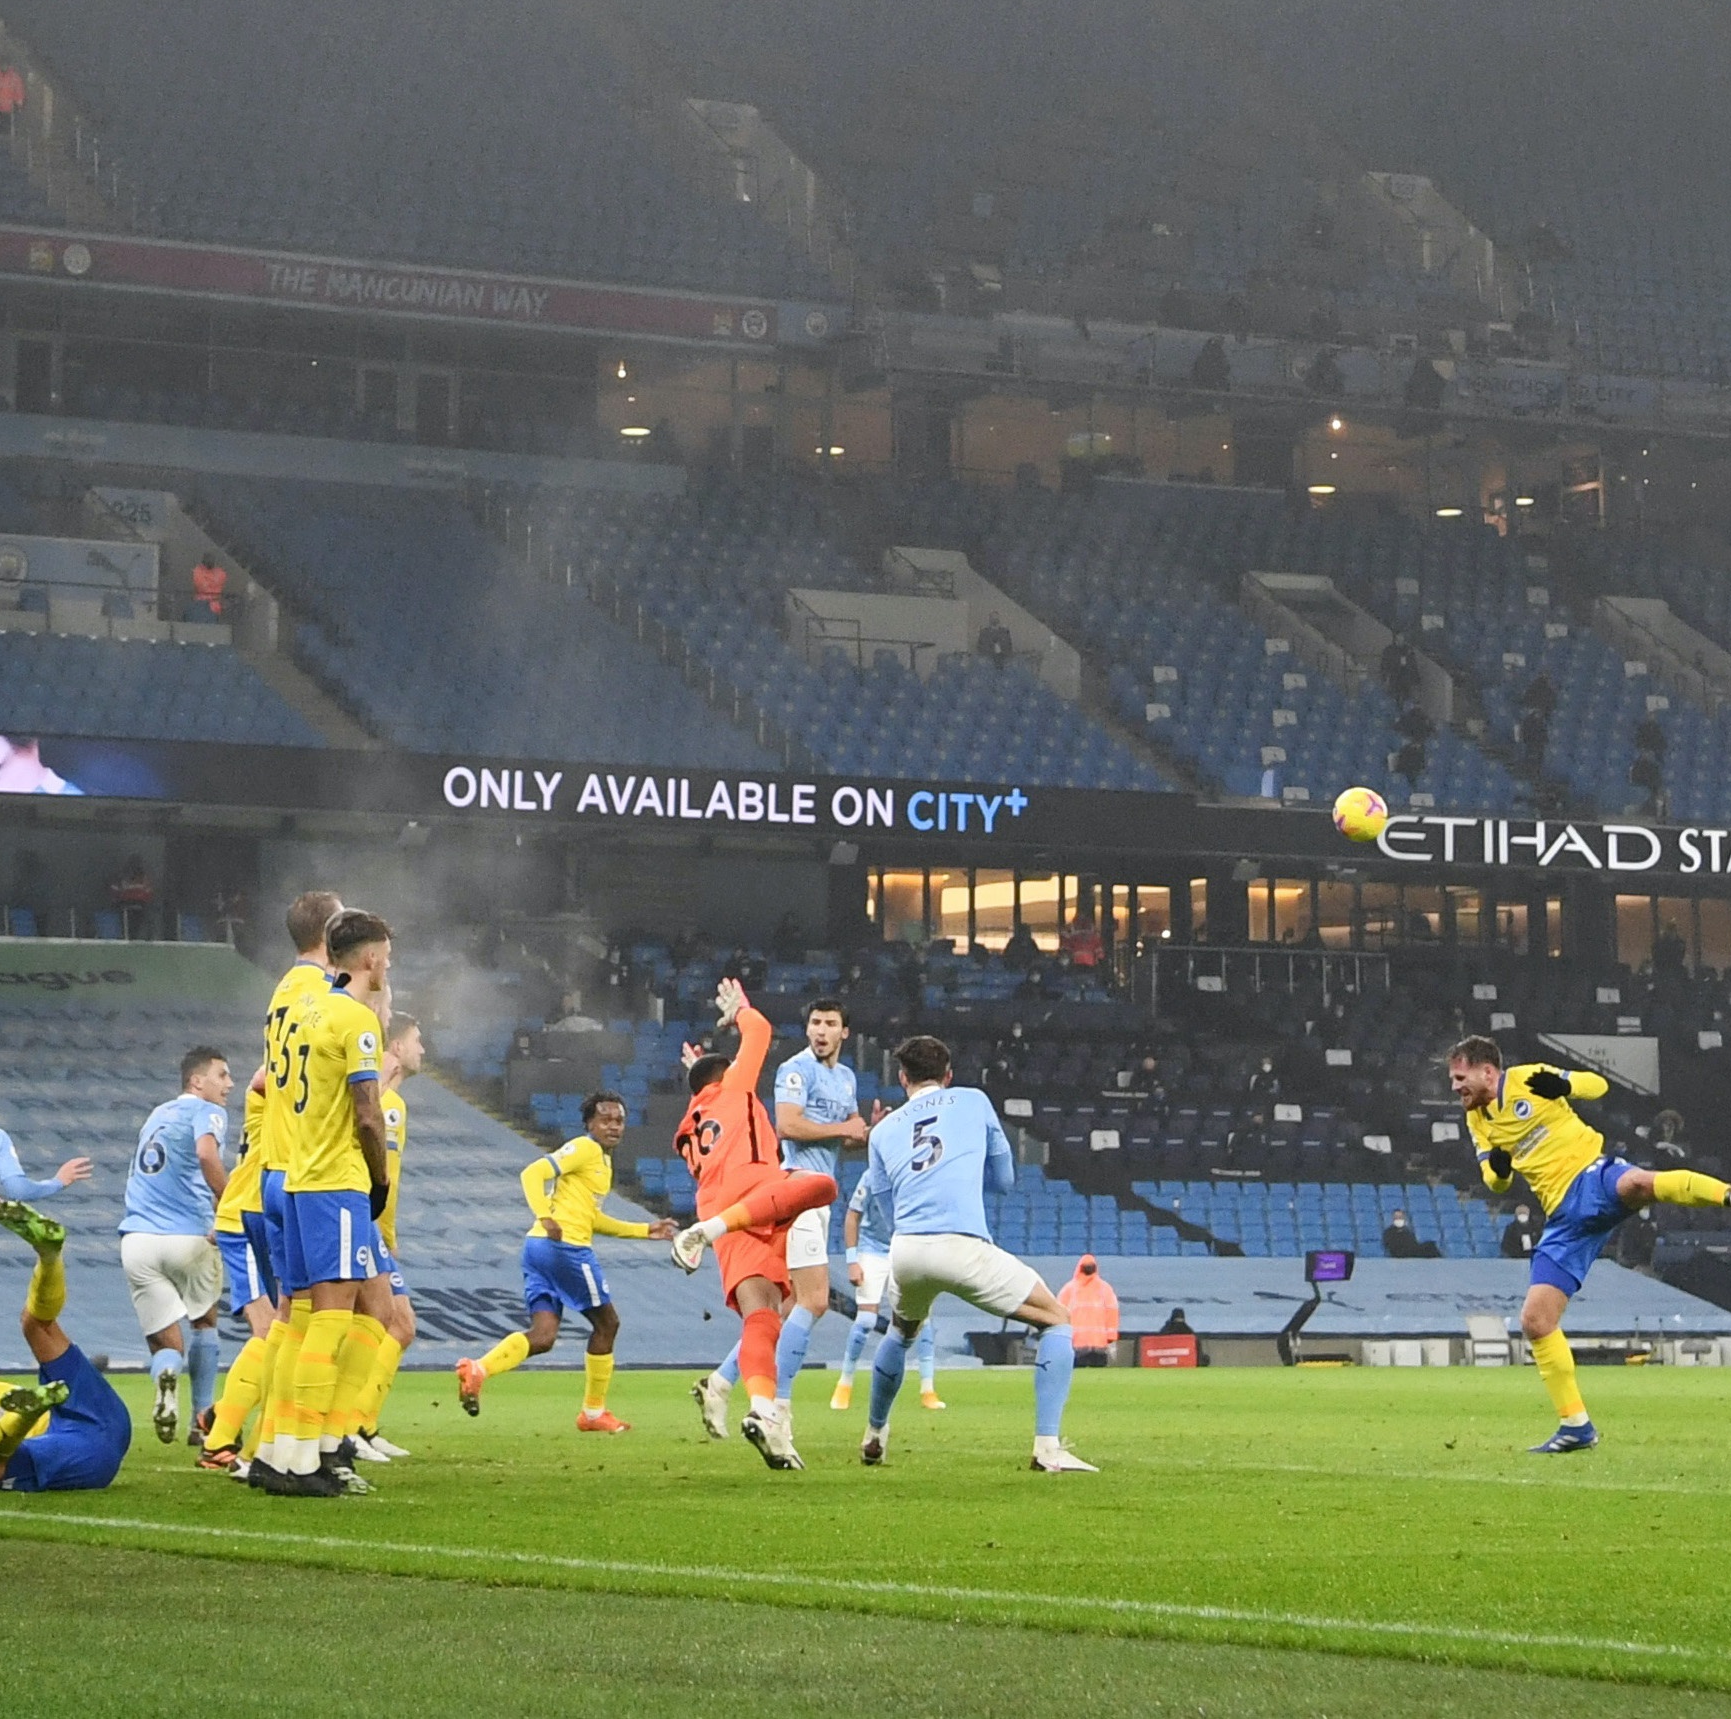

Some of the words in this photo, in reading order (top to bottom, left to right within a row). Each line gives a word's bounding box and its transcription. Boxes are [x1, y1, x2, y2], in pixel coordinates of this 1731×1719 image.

[270, 264, 318, 294] THE
[325, 270, 484, 310] MANCUNIAN
[492, 286, 548, 317] WAY
[442, 766, 563, 811] ONLY
[575, 773, 817, 823] AVAILABLE
[831, 785, 894, 827] ON
[906, 788, 1029, 834] CITY+
[1376, 814, 1662, 871] ETIHAD
[893, 1094, 957, 1124] STONES
[134, 1125, 167, 1176] 6
[910, 1115, 944, 1172] 5
